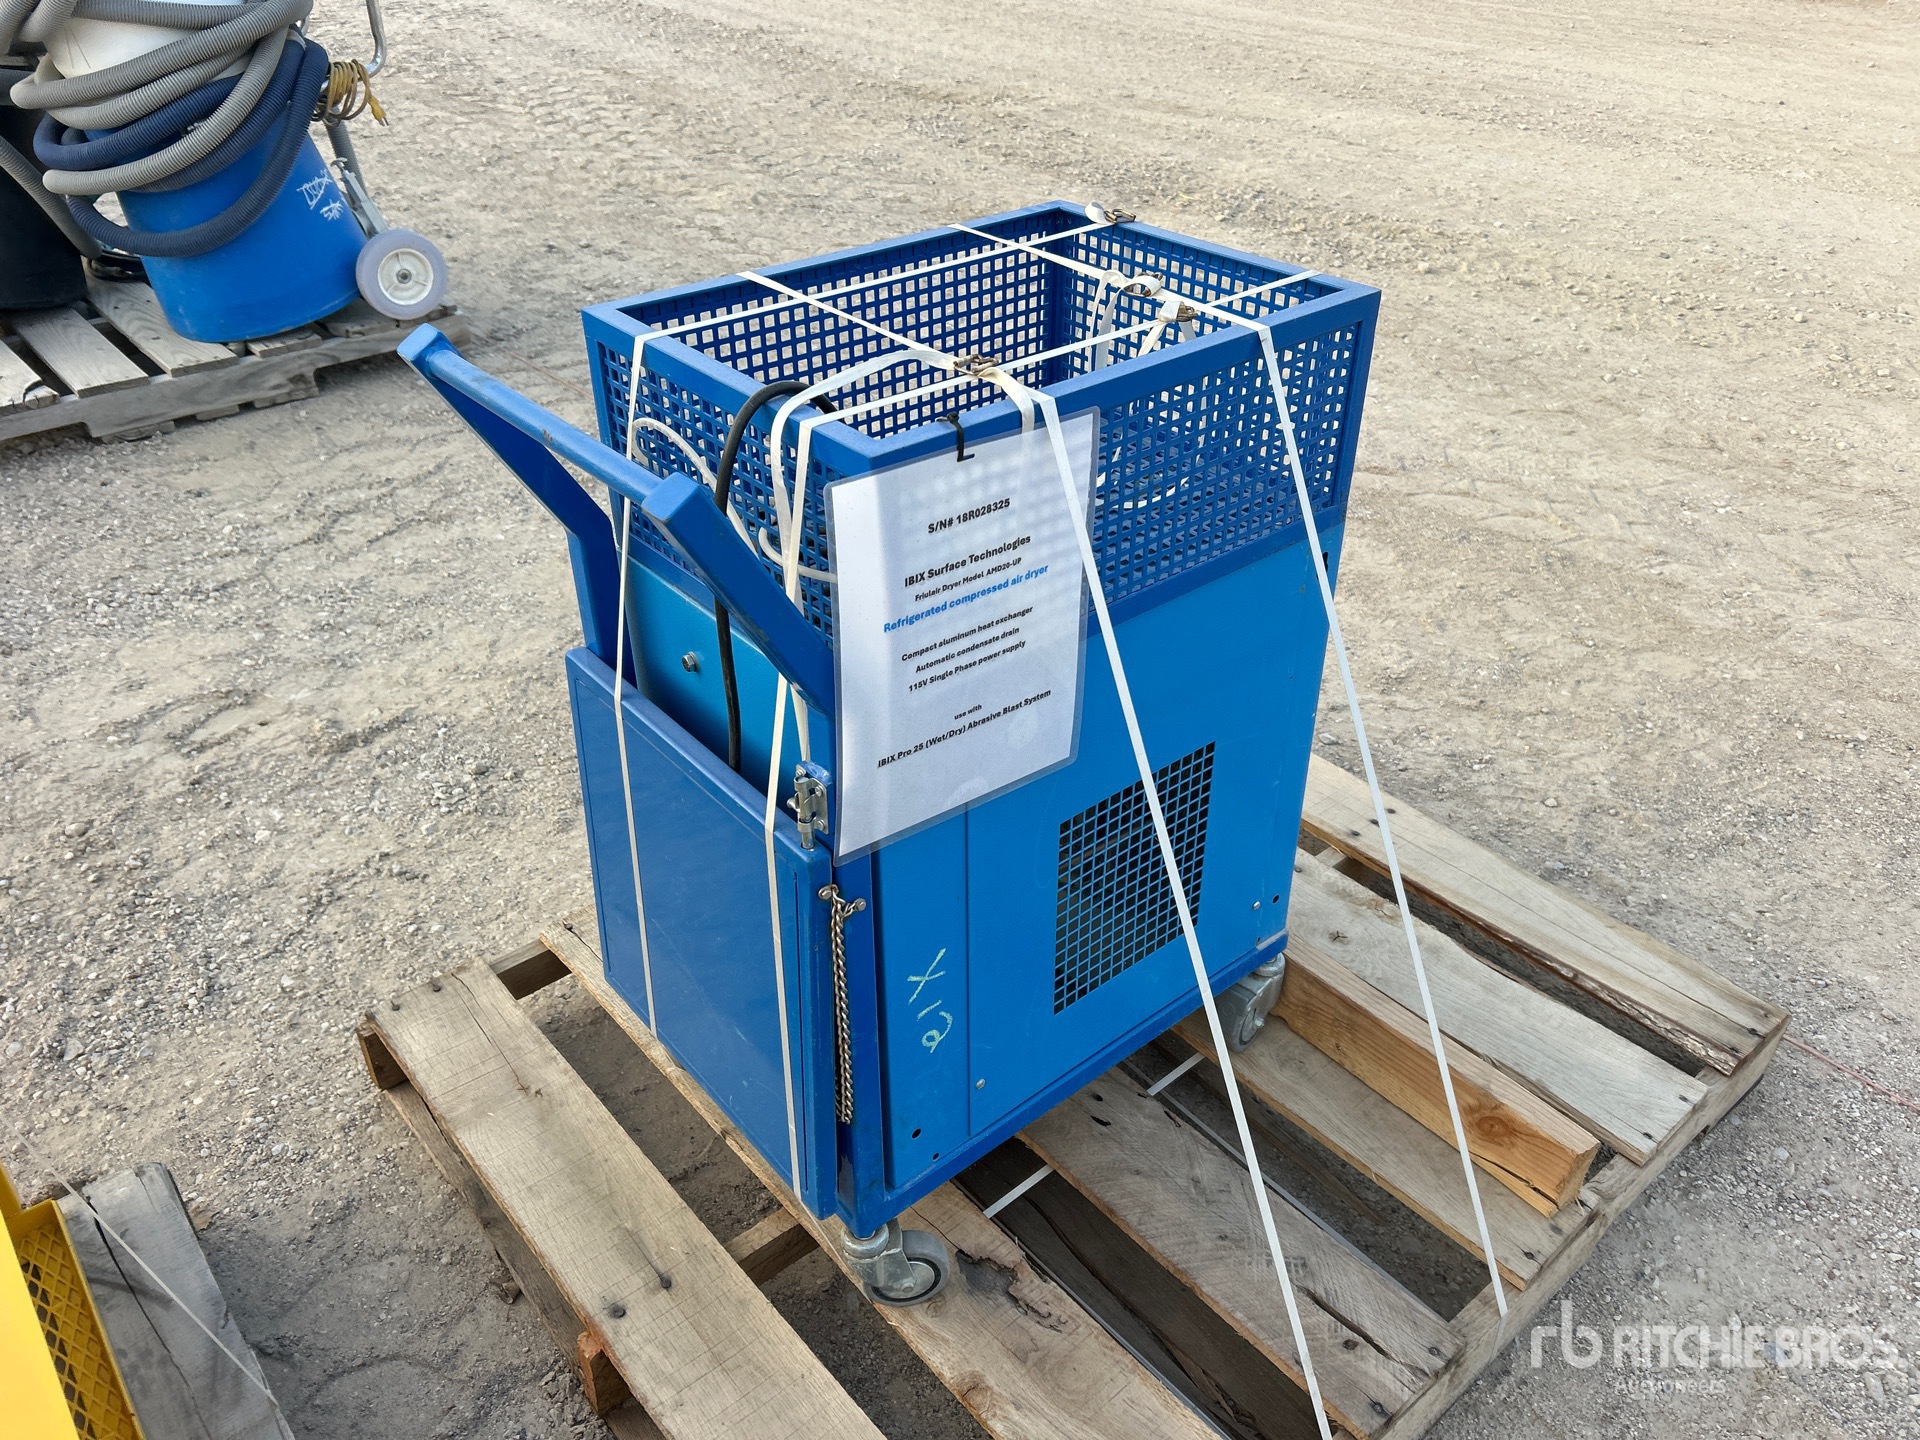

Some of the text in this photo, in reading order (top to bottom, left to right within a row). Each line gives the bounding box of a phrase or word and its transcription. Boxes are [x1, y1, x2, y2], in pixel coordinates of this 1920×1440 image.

[928, 498, 1010, 533] S/N# 18R028325
[905, 536, 1030, 587] IBIX Surface Technologies
[942, 581, 961, 591] Dryer
[963, 571, 984, 584] Model
[884, 565, 1048, 633] Refrigerated compressed air dryer
[902, 607, 1033, 661] Compact aluminum heat exchanger
[916, 628, 1019, 673] Automatic condensate drain
[909, 641, 1025, 691] 115V Single Phase power supply
[878, 690, 1051, 768] IBIX Pro 25 (Wet/Dry) Abrasive Blast System
[955, 705, 982, 720] use with
